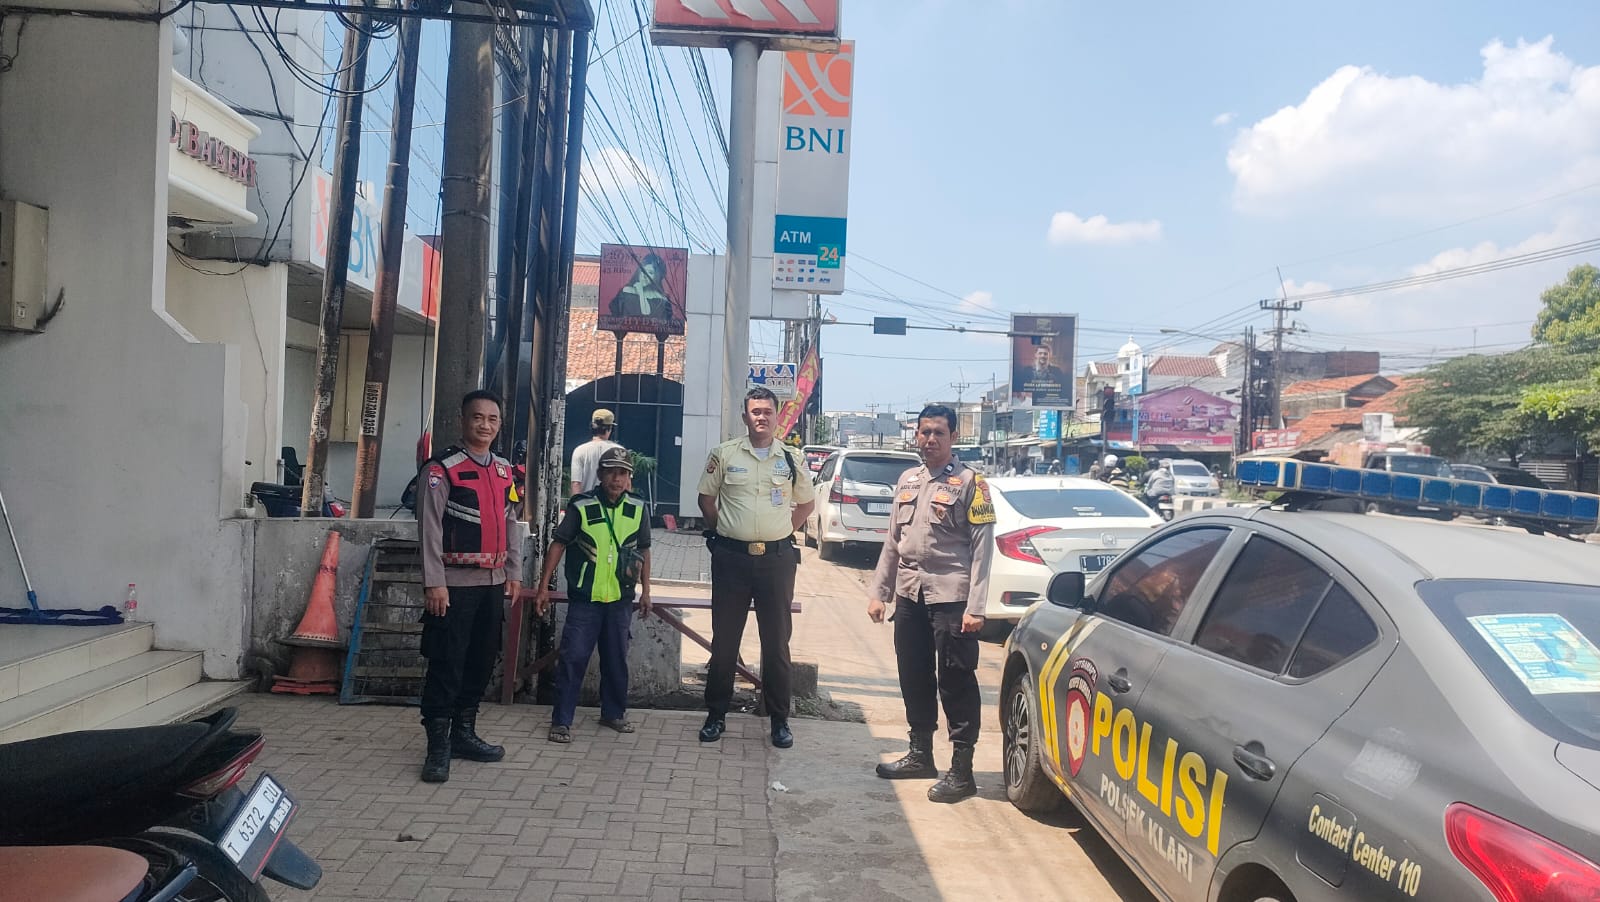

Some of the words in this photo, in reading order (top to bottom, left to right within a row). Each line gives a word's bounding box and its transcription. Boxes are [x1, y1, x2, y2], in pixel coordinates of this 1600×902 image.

[178, 120, 256, 187] BAKERY
[784, 125, 845, 154] BNI
[780, 230, 812, 244] ATM
[820, 246, 838, 261] 24
[749, 365, 794, 378] YKA
[1081, 556, 1088, 566] T
[1092, 690, 1228, 858] POLISI
[227, 842, 240, 857] T
[239, 806, 265, 842] 6372
[262, 783, 279, 805] CU
[1101, 773, 1147, 840] POLSEK
[1148, 817, 1194, 884] KLARI
[1308, 804, 1354, 854] Contact
[1353, 831, 1397, 882] Center
[1398, 858, 1421, 897] 110
